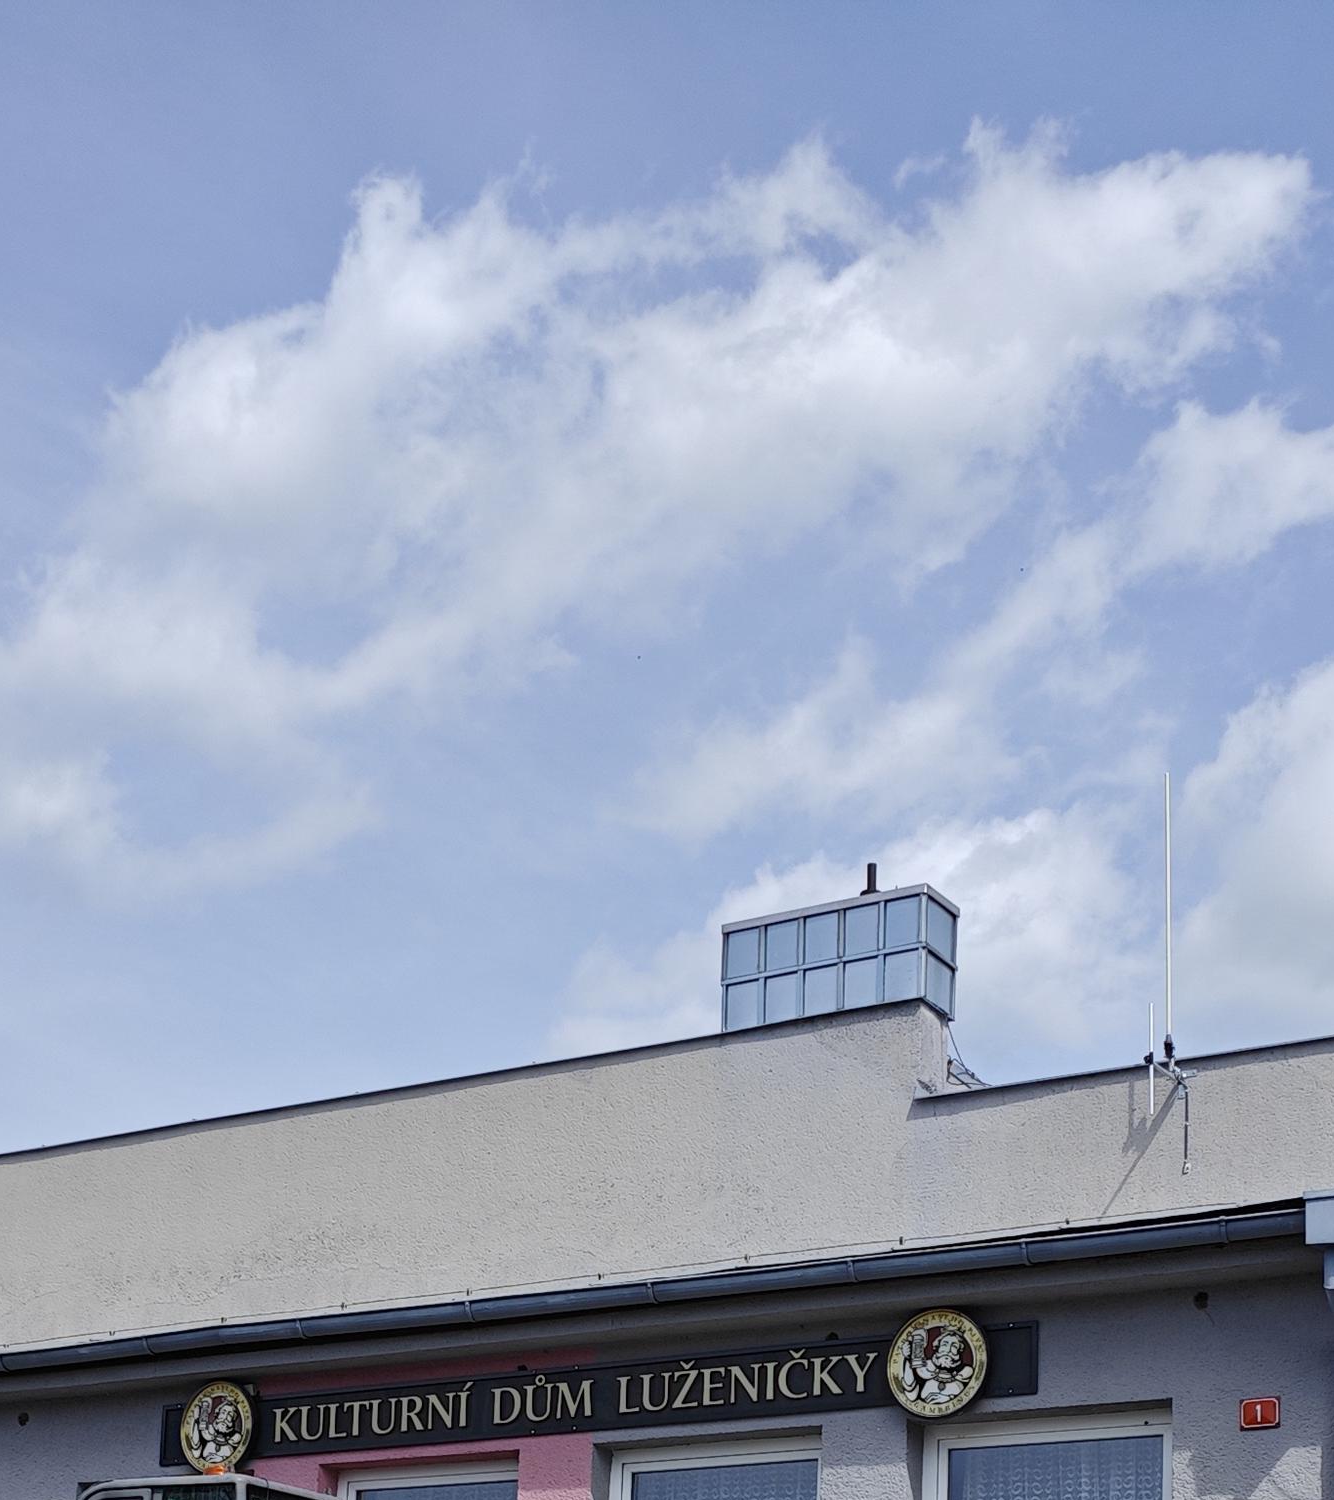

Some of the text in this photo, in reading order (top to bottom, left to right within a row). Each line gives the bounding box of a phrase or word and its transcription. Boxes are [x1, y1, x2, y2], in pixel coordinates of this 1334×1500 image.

[272, 1381, 475, 1443] KULTURNÍ
[490, 1374, 594, 1425] DŮM
[617, 1348, 879, 1414] LUŽENIČKY
[1255, 1402, 1262, 1423] 1
